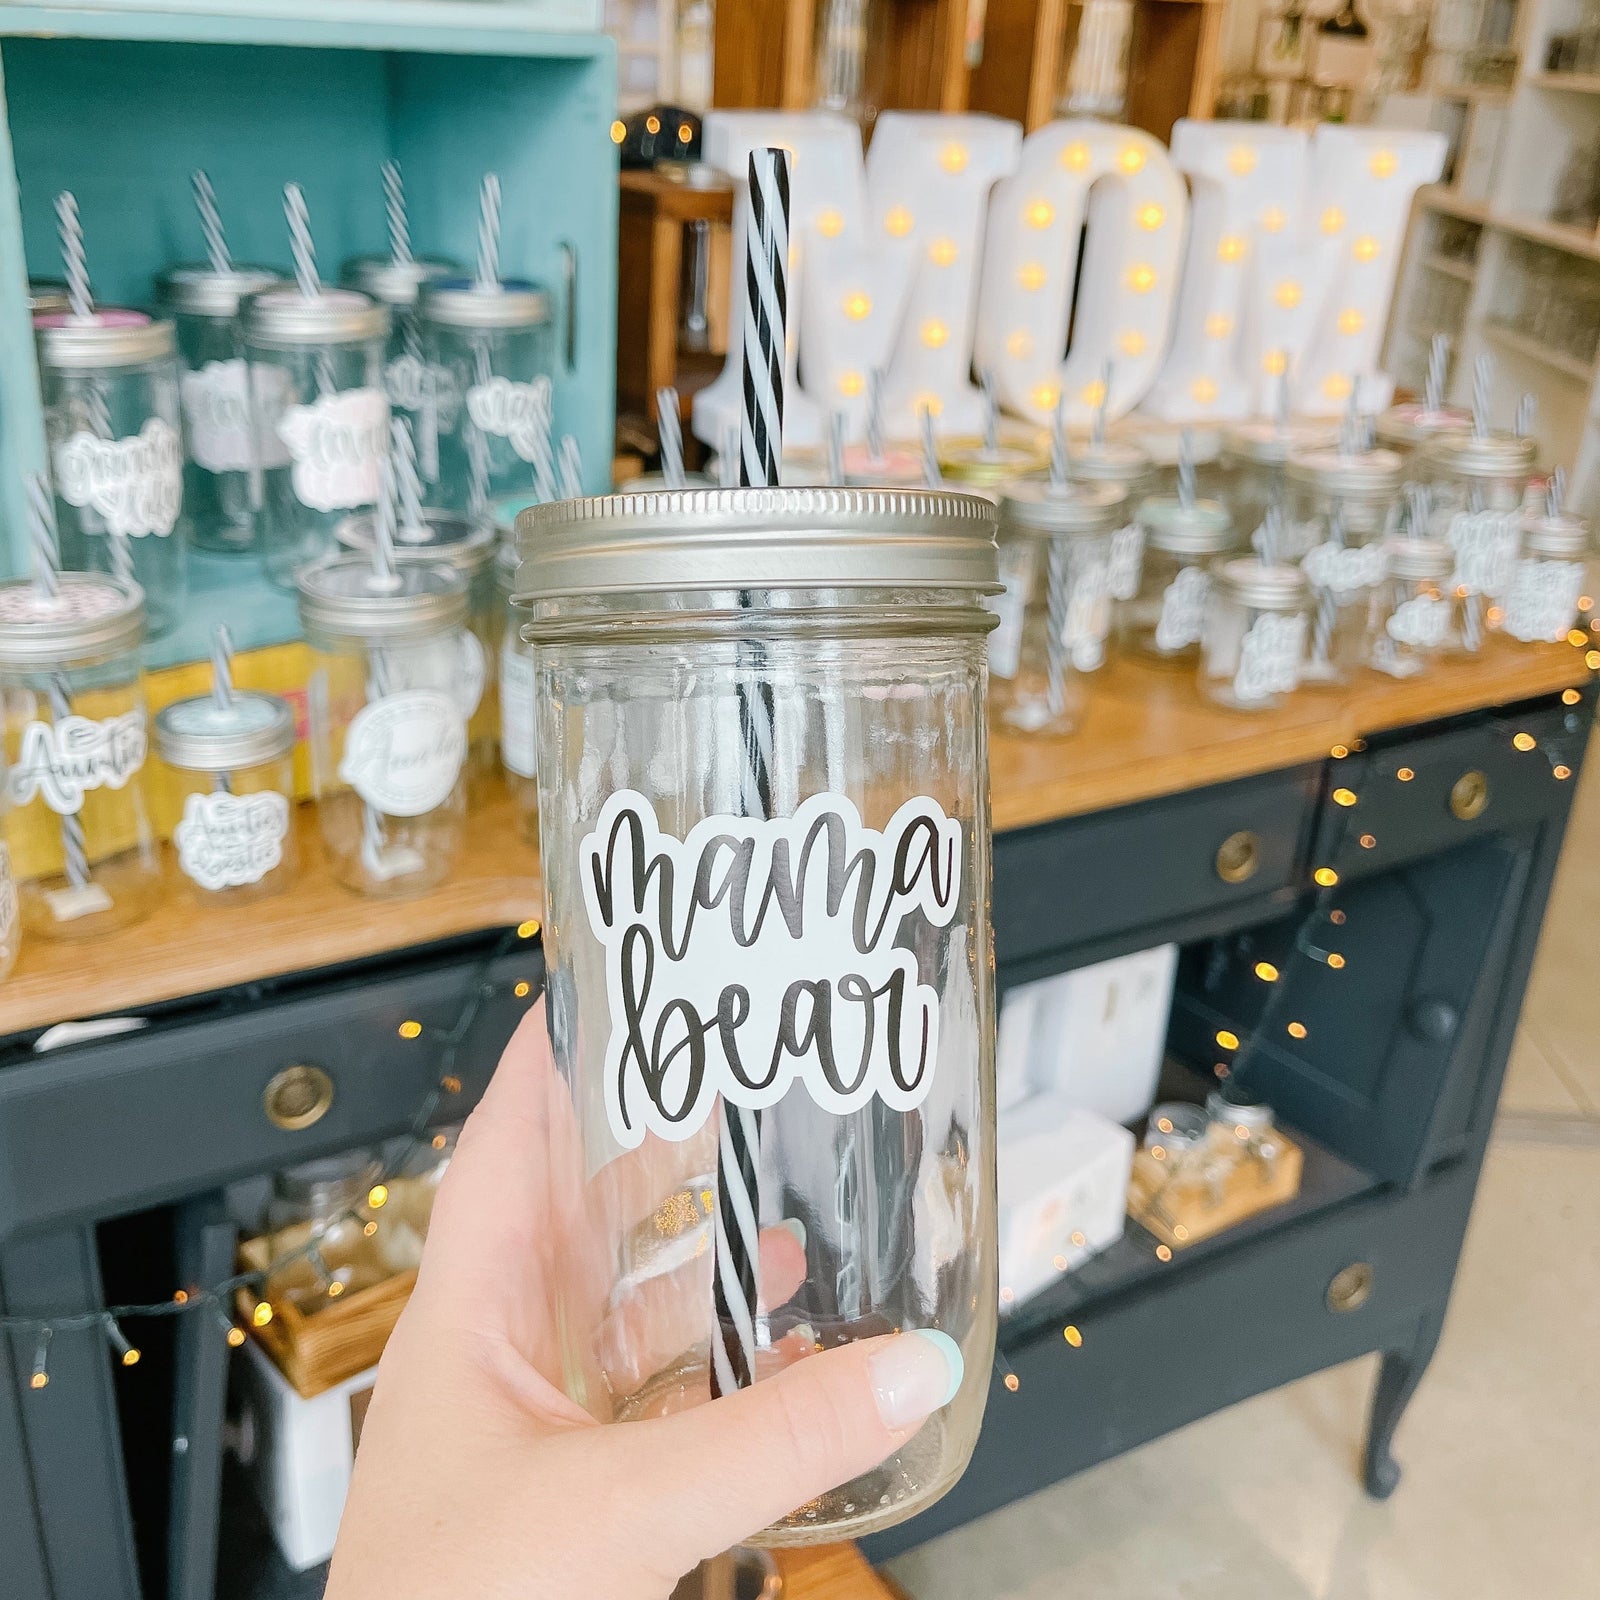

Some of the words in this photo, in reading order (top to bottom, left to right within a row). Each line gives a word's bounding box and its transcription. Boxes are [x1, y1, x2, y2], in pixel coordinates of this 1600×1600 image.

[691, 109, 1448, 446] MOM
[591, 808, 953, 962] mama
[618, 923, 929, 1130] bear
